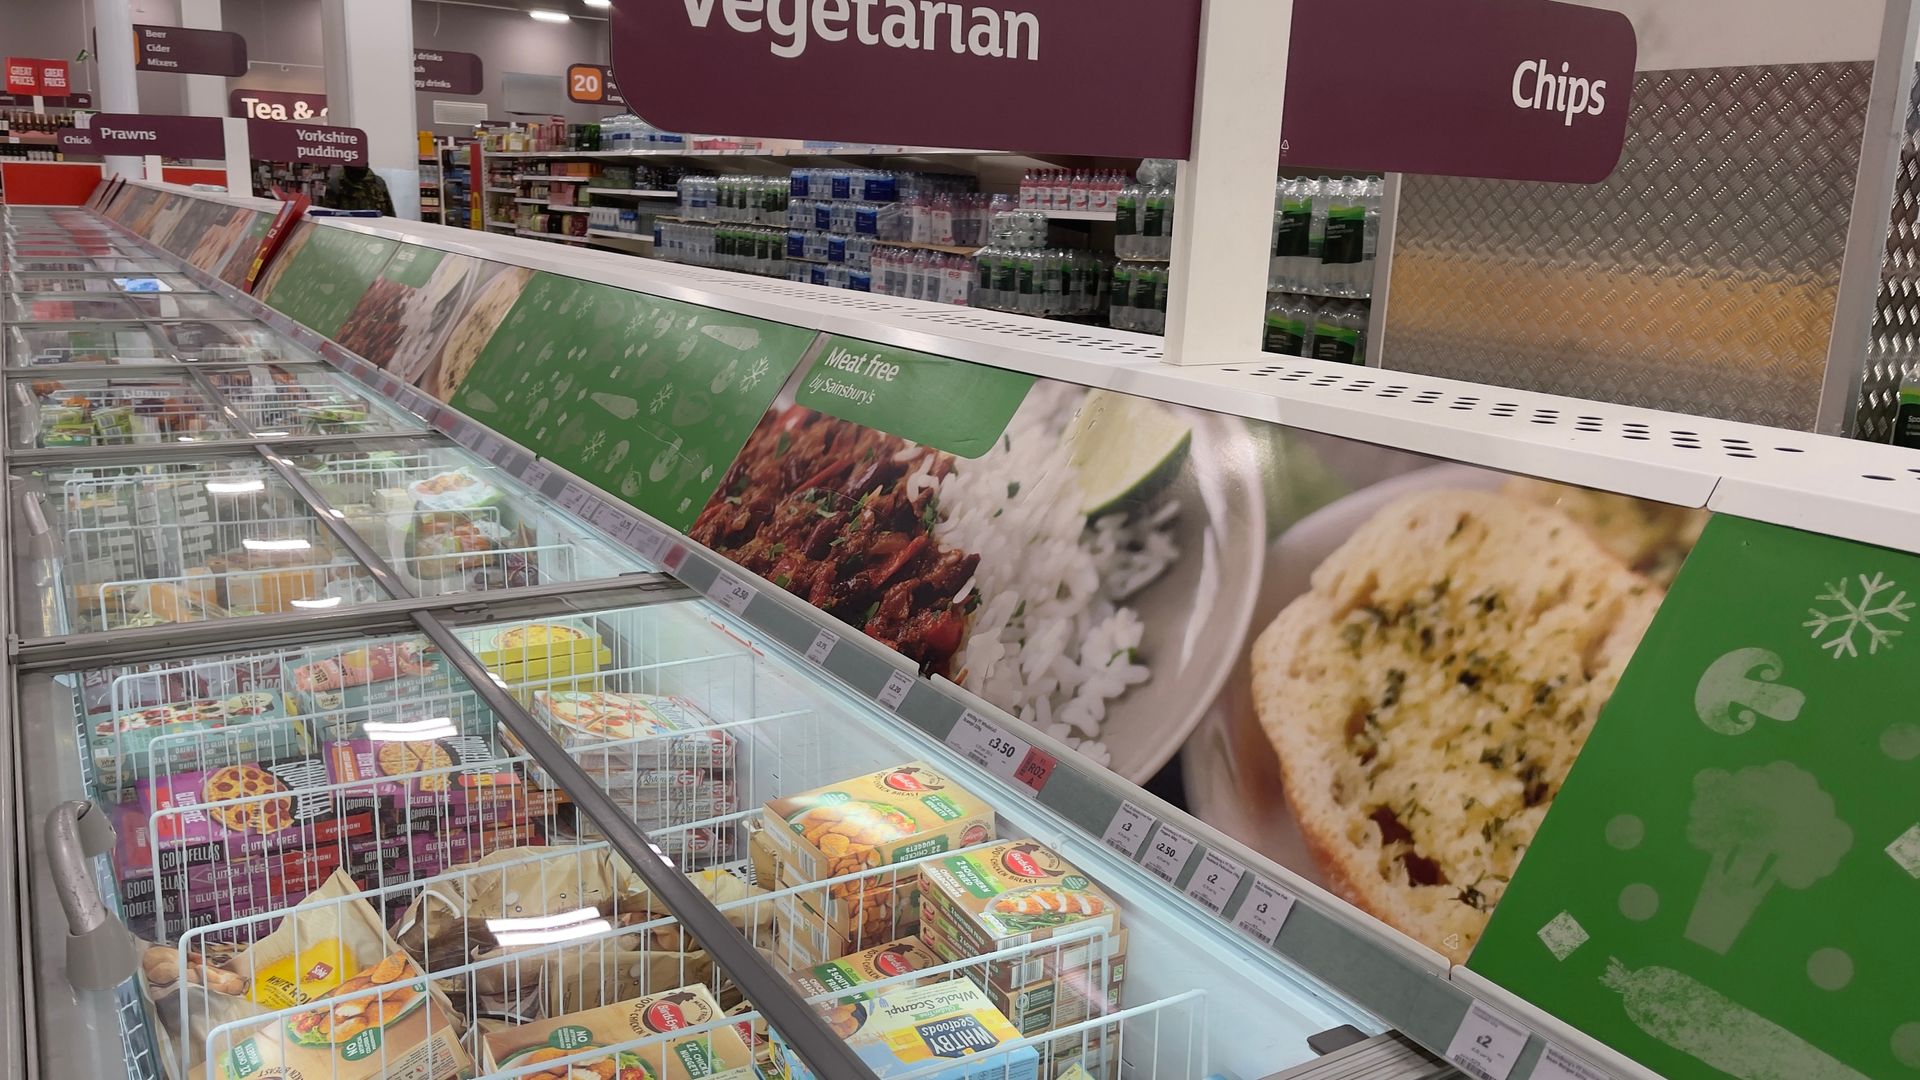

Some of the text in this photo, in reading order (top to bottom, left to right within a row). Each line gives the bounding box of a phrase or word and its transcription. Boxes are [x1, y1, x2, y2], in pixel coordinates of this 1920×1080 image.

[145, 29, 167, 39] Beer
[146, 43, 171, 53] Cider
[147, 58, 178, 67] Mixers
[574, 74, 598, 92] 20
[1512, 58, 1607, 126] Chips
[241, 97, 288, 121] Tea
[292, 101, 314, 120] &
[63, 135, 92, 144] Chick
[100, 127, 157, 140] Prawns
[296, 129, 358, 145] Yorkshire
[296, 145, 359, 162] puddings
[824, 346, 900, 382] Meat free
[808, 372, 876, 406] by Sainsbury's
[988, 737, 1016, 758] £3.50
[1028, 762, 1046, 779] R02
[1121, 822, 1133, 832] £3
[1156, 842, 1176, 858] £2.50
[955, 871, 973, 887] FRIED
[1008, 874, 1038, 884] BREAST
[1206, 873, 1218, 885] £2
[1256, 903, 1268, 914] £3
[884, 990, 979, 1018] Whole Scampi
[922, 1016, 975, 1037] Seafoods
[576, 1030, 589, 1044] NO
[929, 1026, 996, 1055] WHITBY
[1475, 1035, 1493, 1049] £2
[346, 1042, 357, 1057] NO
[692, 1050, 709, 1074] CHICKE
